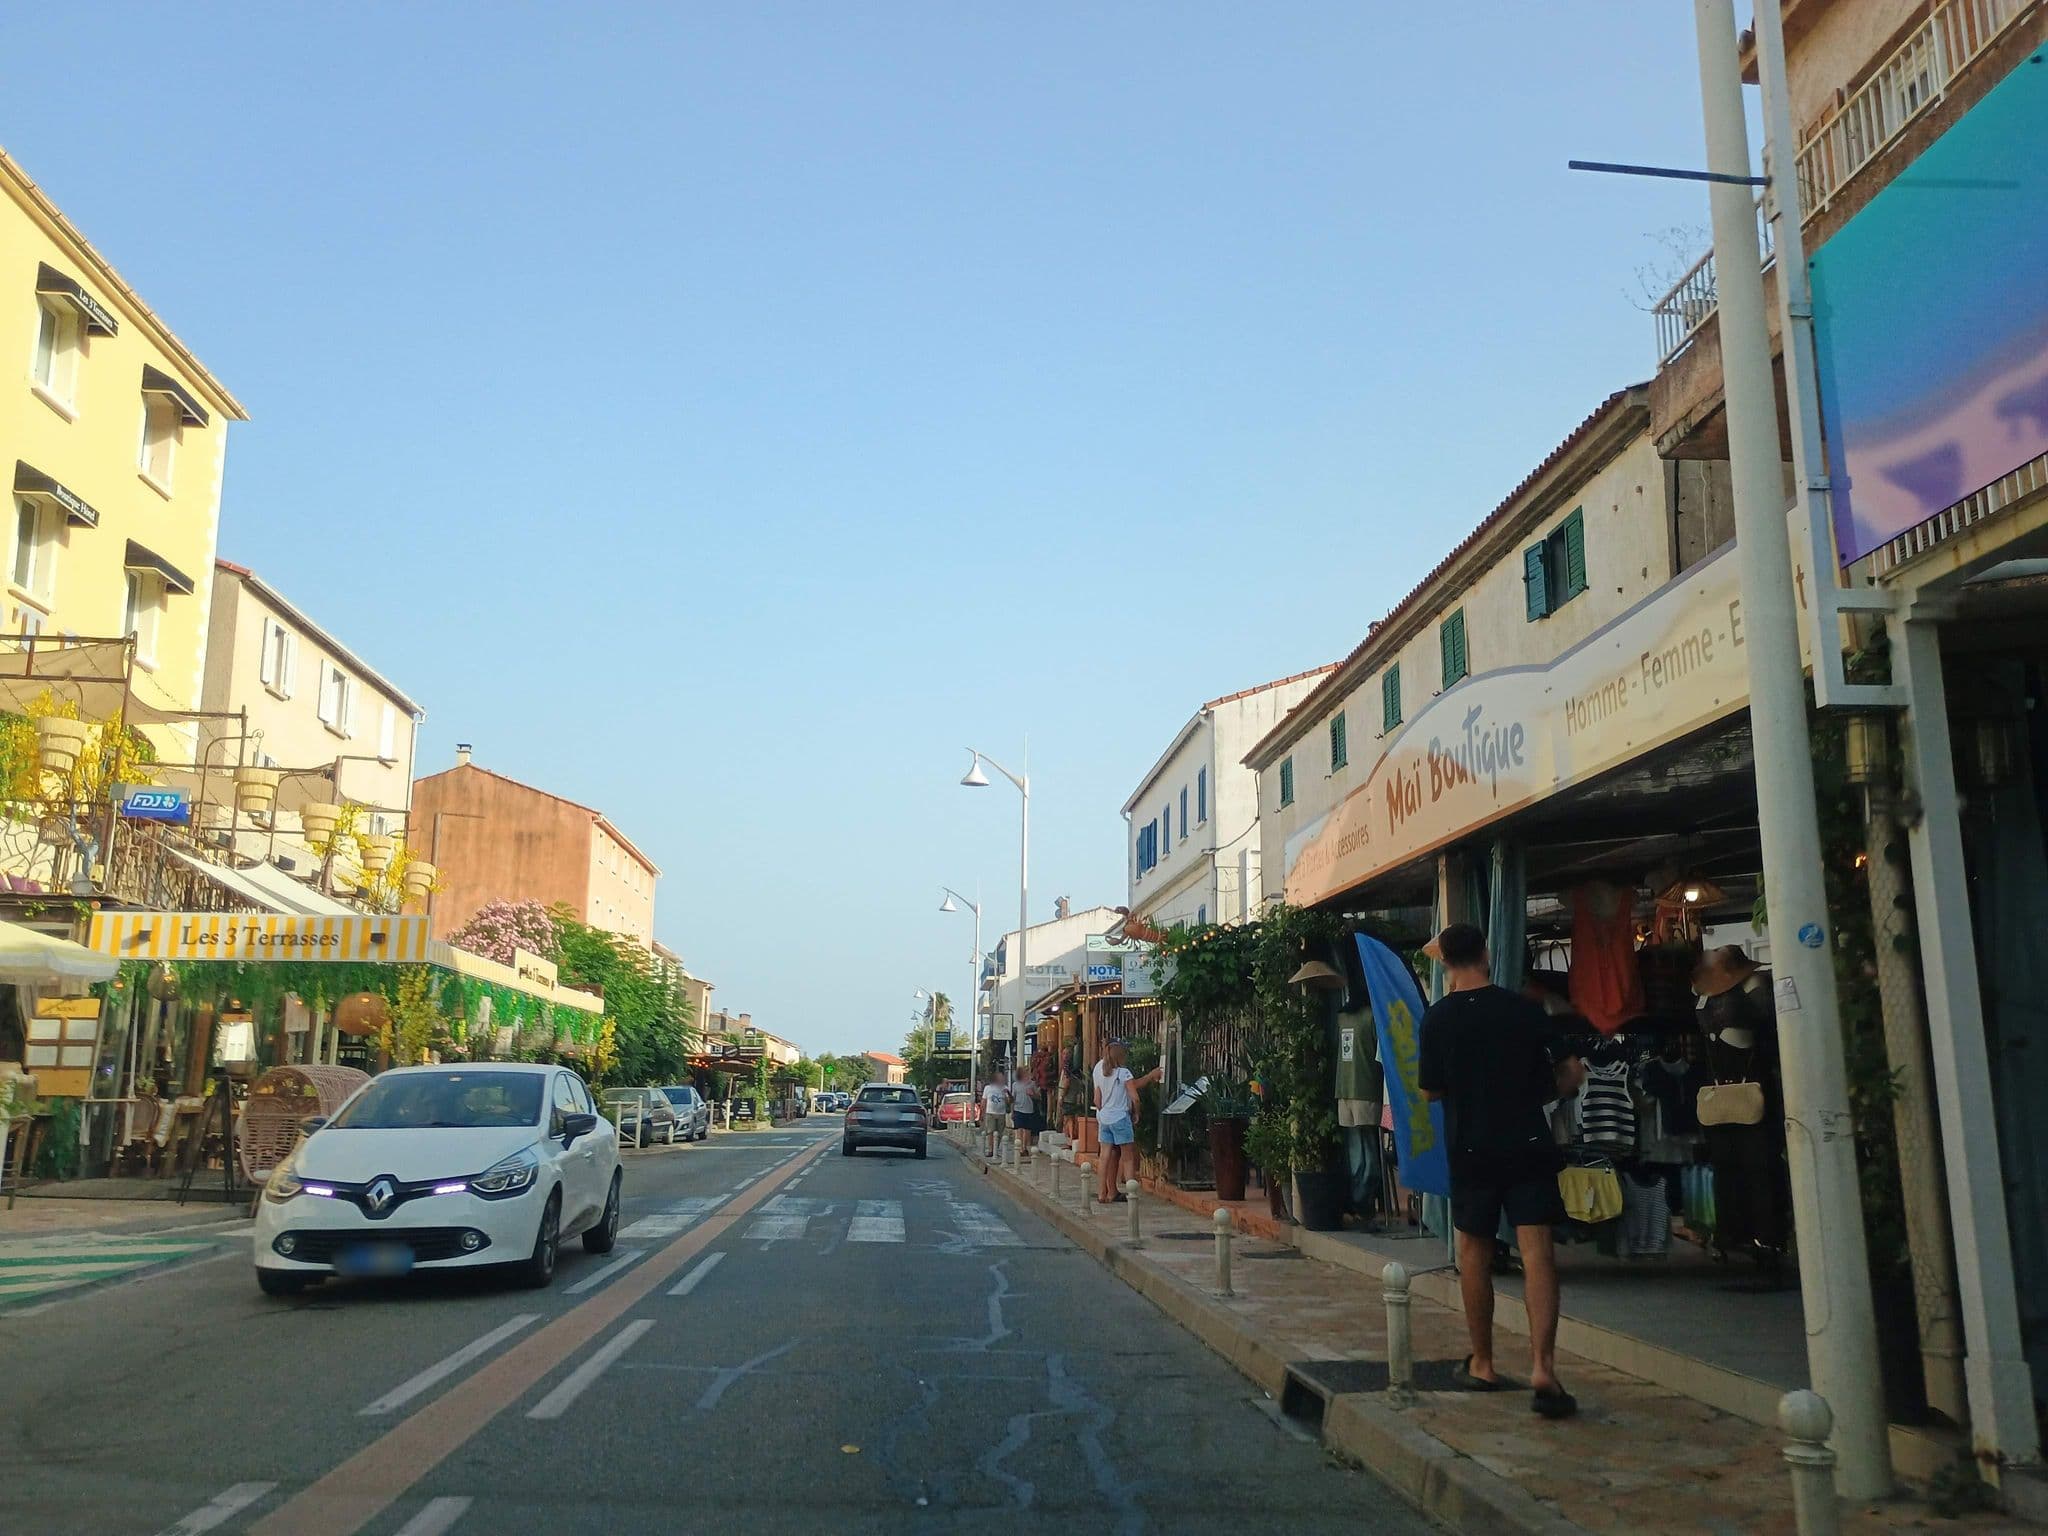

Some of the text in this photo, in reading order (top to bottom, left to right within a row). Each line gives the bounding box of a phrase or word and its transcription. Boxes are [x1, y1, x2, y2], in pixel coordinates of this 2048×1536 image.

[1565, 674, 1628, 737] Homme
[1640, 626, 1713, 696] Femme
[132, 794, 162, 807] FDJ
[1386, 757, 1422, 837] Maï
[181, 926, 340, 947] Les 3 Terrasses
[1088, 966, 1122, 976] HOTE
